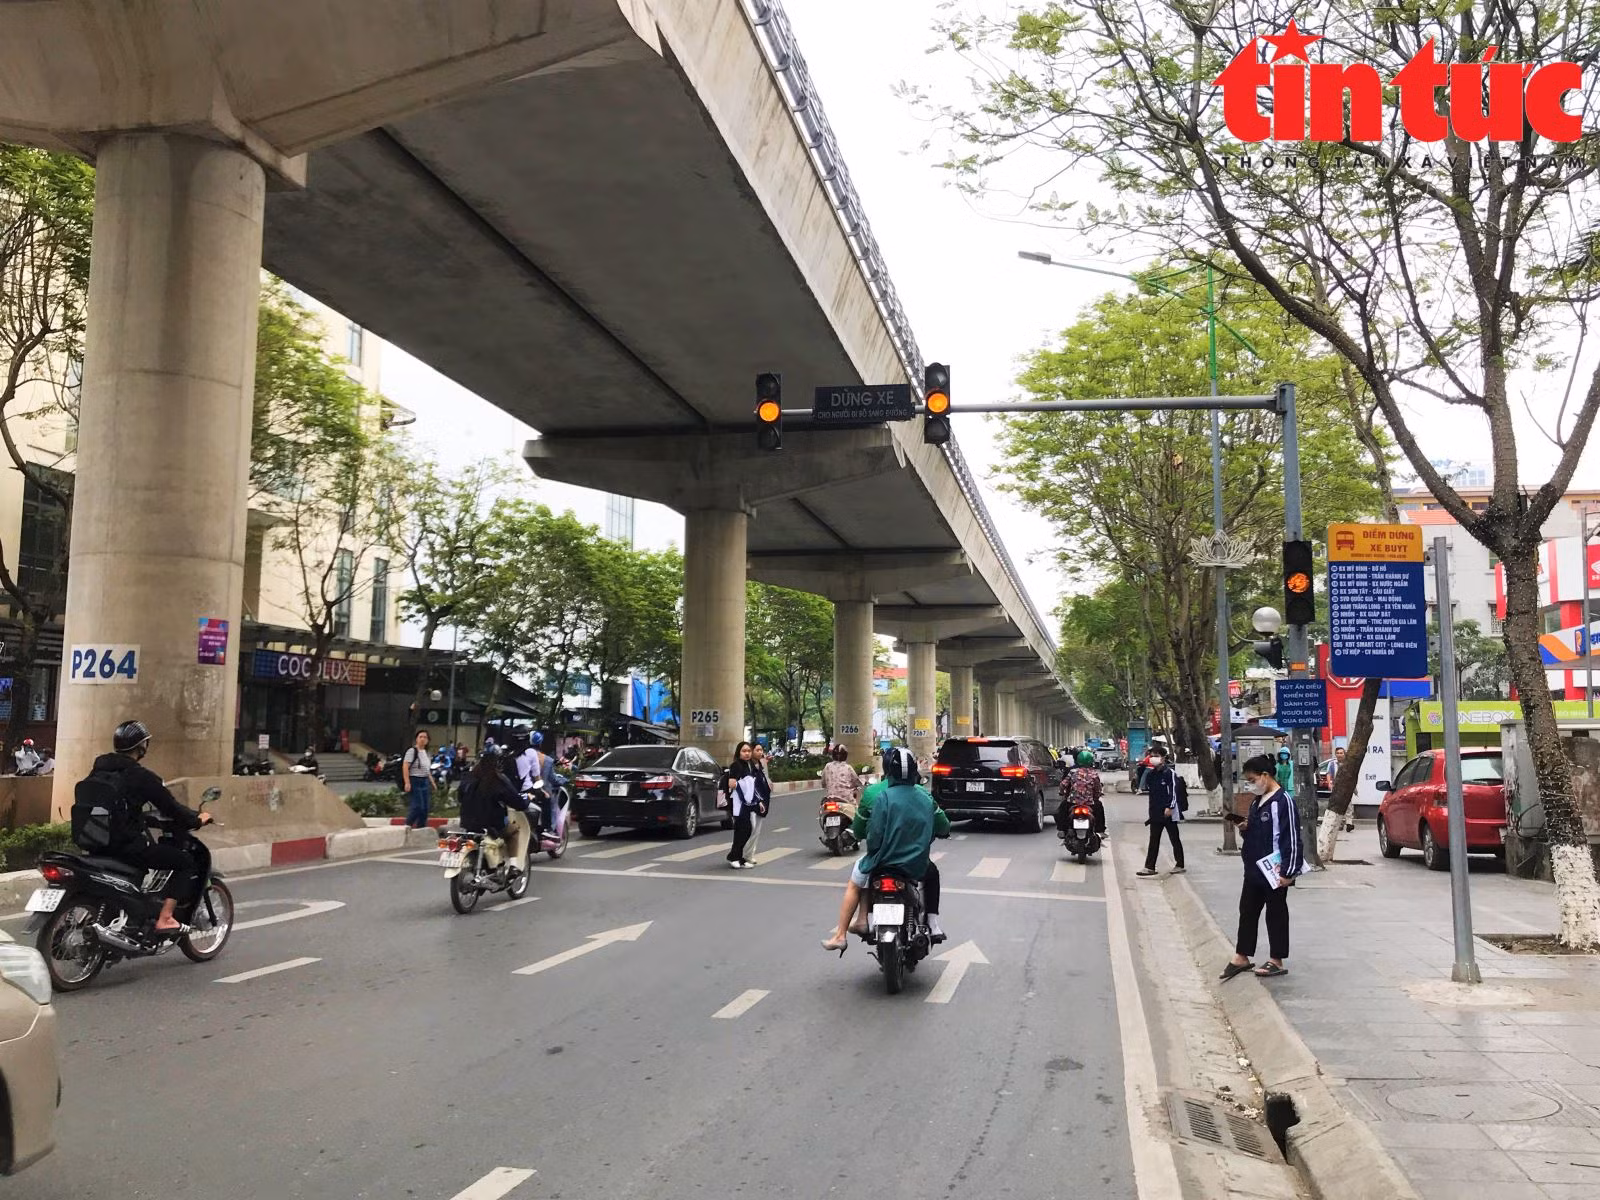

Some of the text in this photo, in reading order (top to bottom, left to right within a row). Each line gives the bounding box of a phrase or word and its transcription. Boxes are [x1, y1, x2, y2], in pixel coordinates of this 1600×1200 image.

[831, 388, 894, 407] DỪNG XE
[1370, 544, 1382, 552] XE
[72, 648, 137, 679] P264
[691, 711, 719, 723] P265
[841, 725, 859, 733] P266
[1372, 746, 1384, 754] RA
